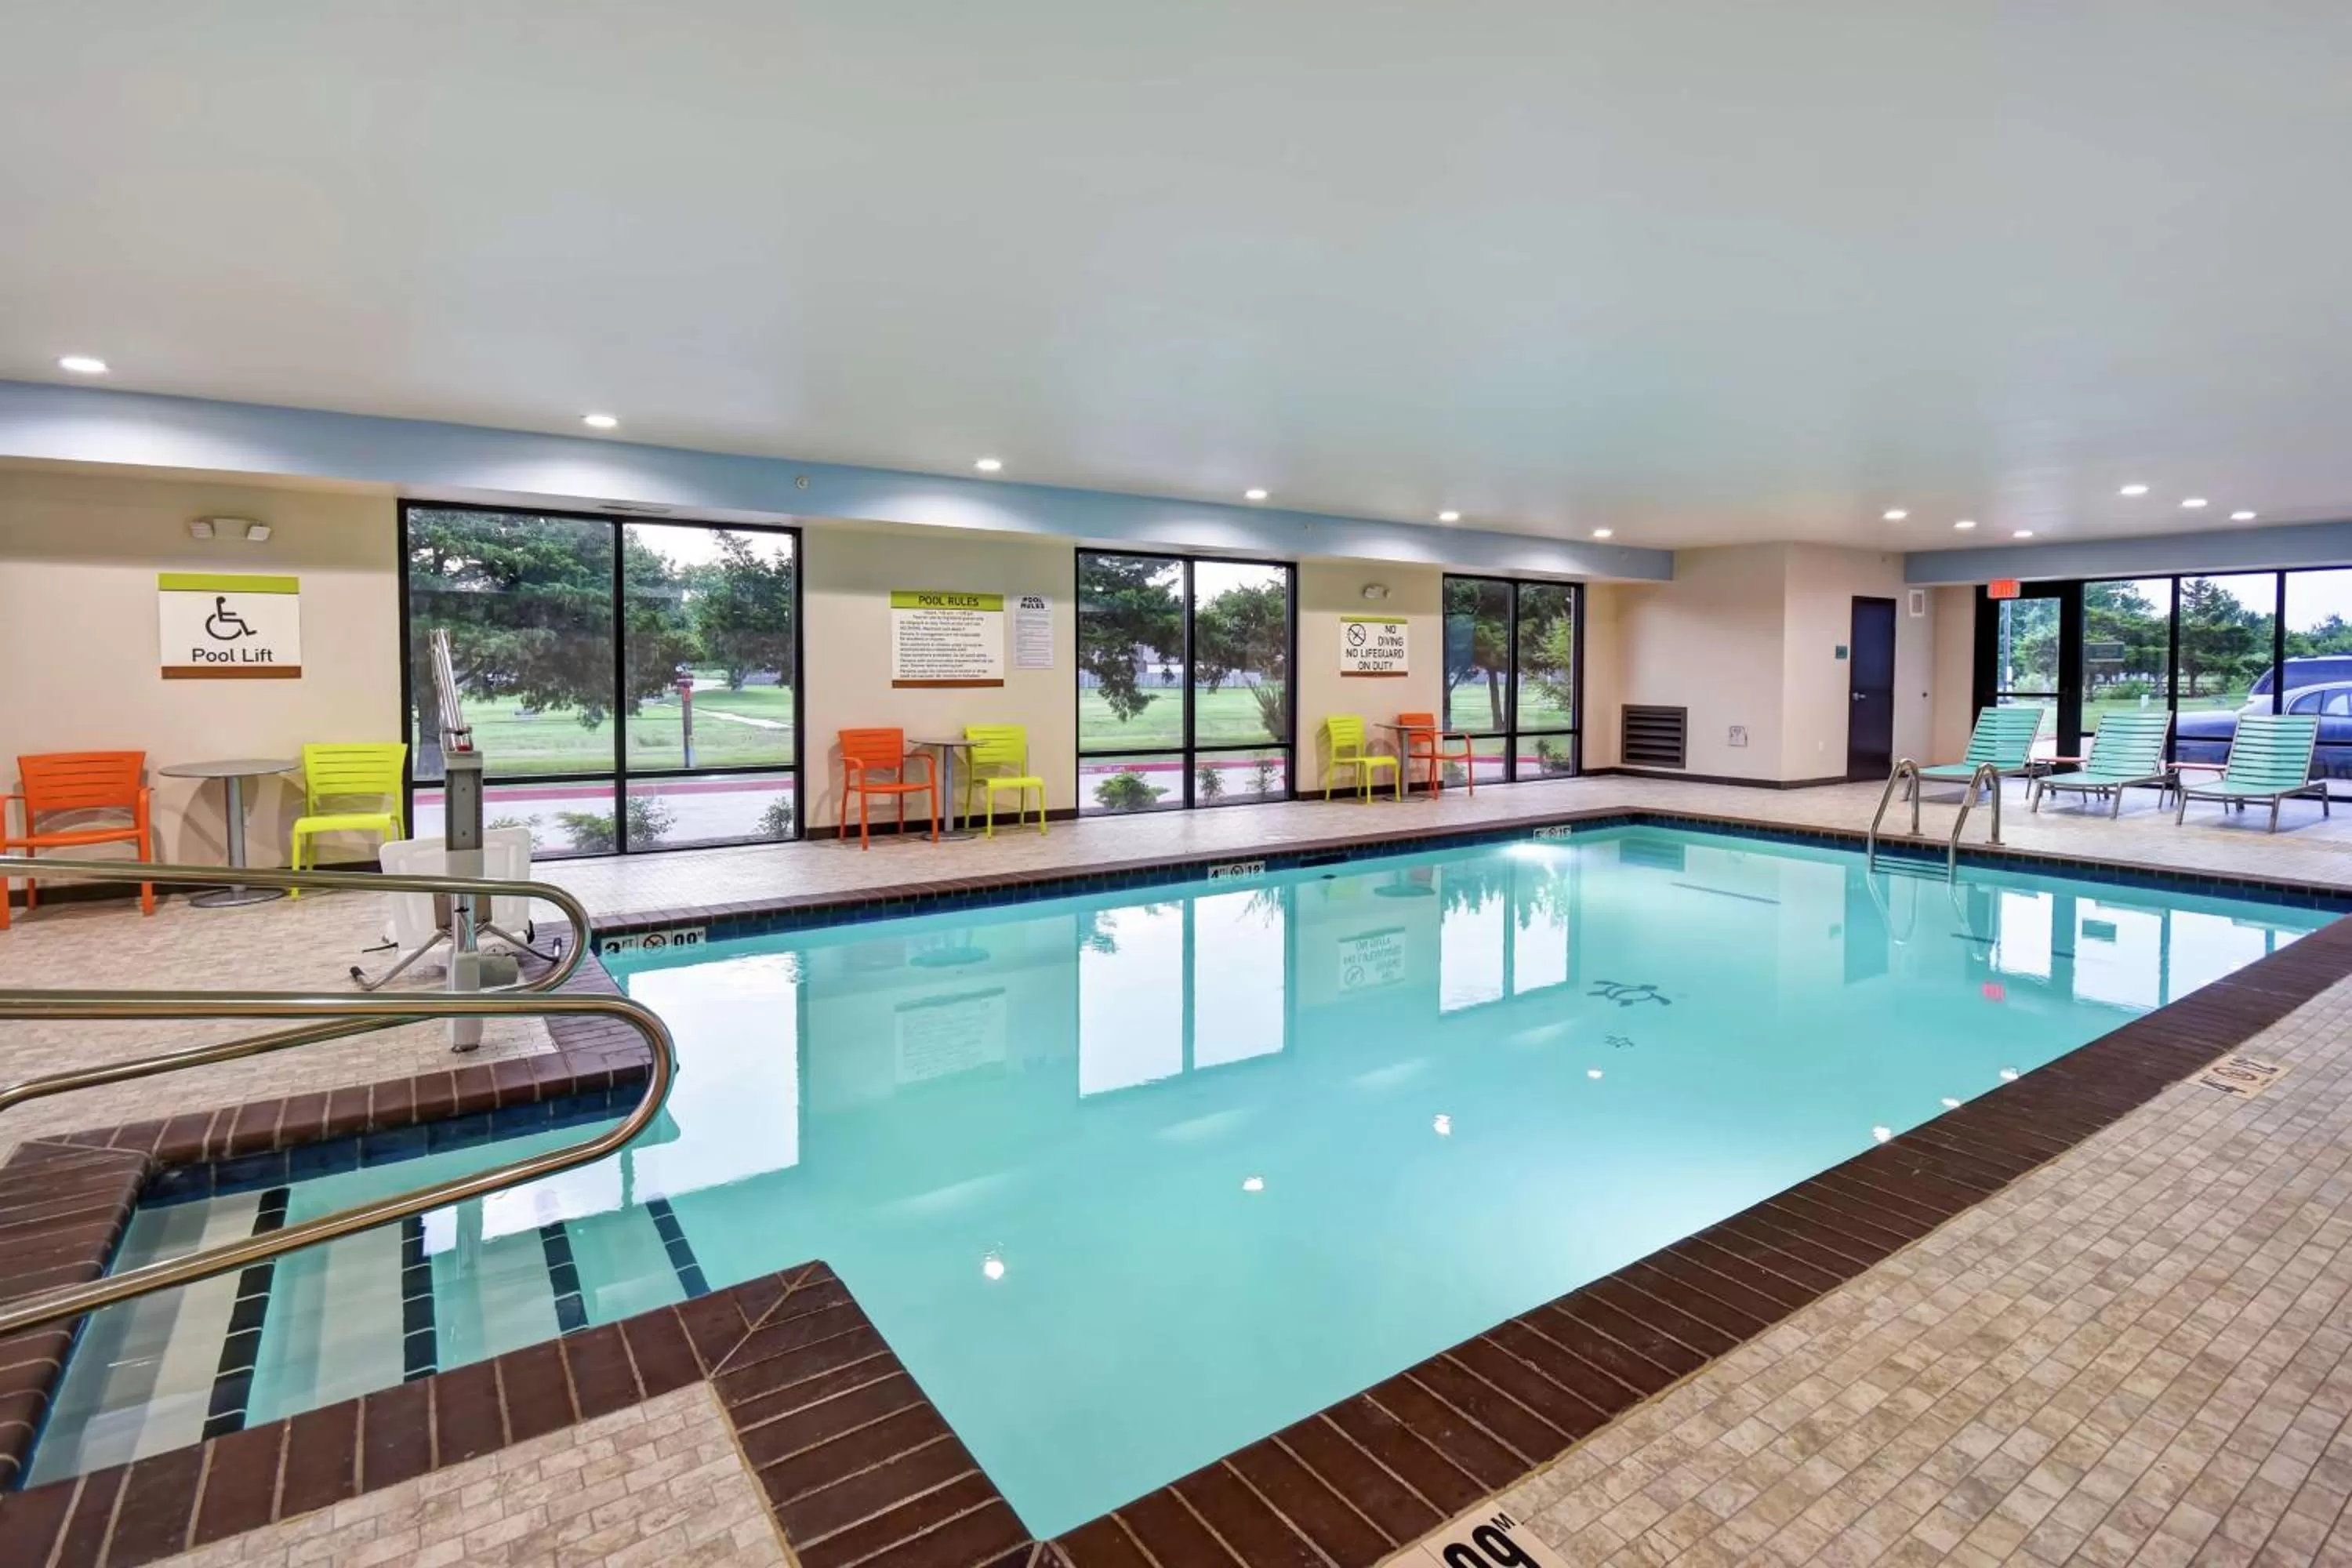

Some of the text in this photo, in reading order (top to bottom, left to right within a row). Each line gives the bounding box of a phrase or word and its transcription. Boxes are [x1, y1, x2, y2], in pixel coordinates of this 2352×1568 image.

[918, 595, 979, 607] POOL RULES
[1385, 624, 1396, 633] NO
[1377, 636, 1404, 647] DIVING
[192, 648, 274, 662] Pool Lift
[1346, 648, 1404, 659] NO LIFEGUARD
[1357, 661, 1393, 670] ON DUTY
